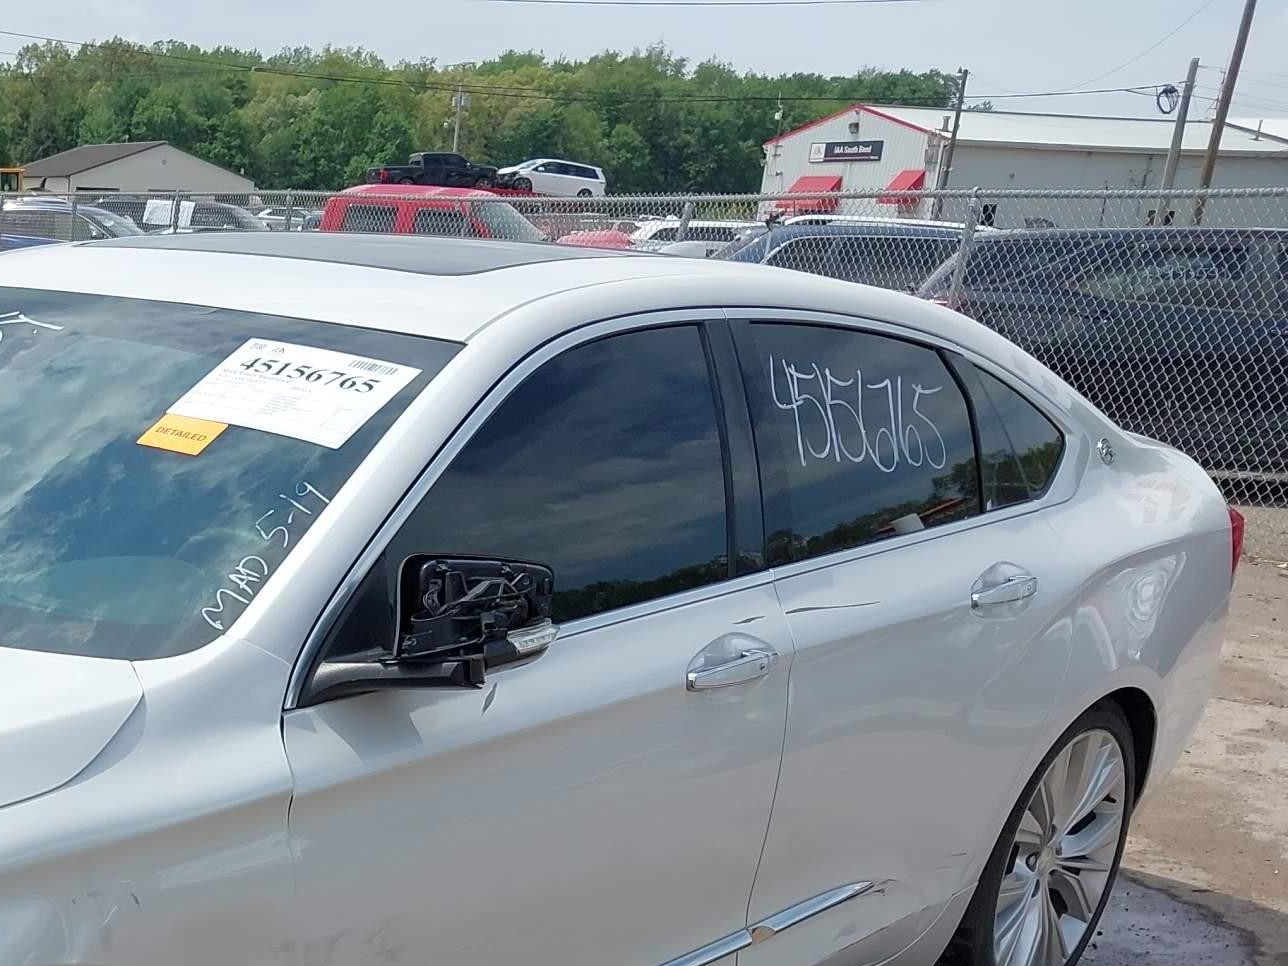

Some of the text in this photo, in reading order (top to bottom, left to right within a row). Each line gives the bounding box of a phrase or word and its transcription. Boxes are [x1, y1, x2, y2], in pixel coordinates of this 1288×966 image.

[844, 144, 859, 154] South
[240, 357, 381, 393] 45156765
[769, 353, 947, 473] 45156765
[155, 426, 207, 442] DETAILED
[201, 555, 269, 631] MAD
[255, 481, 331, 549] 5-19
